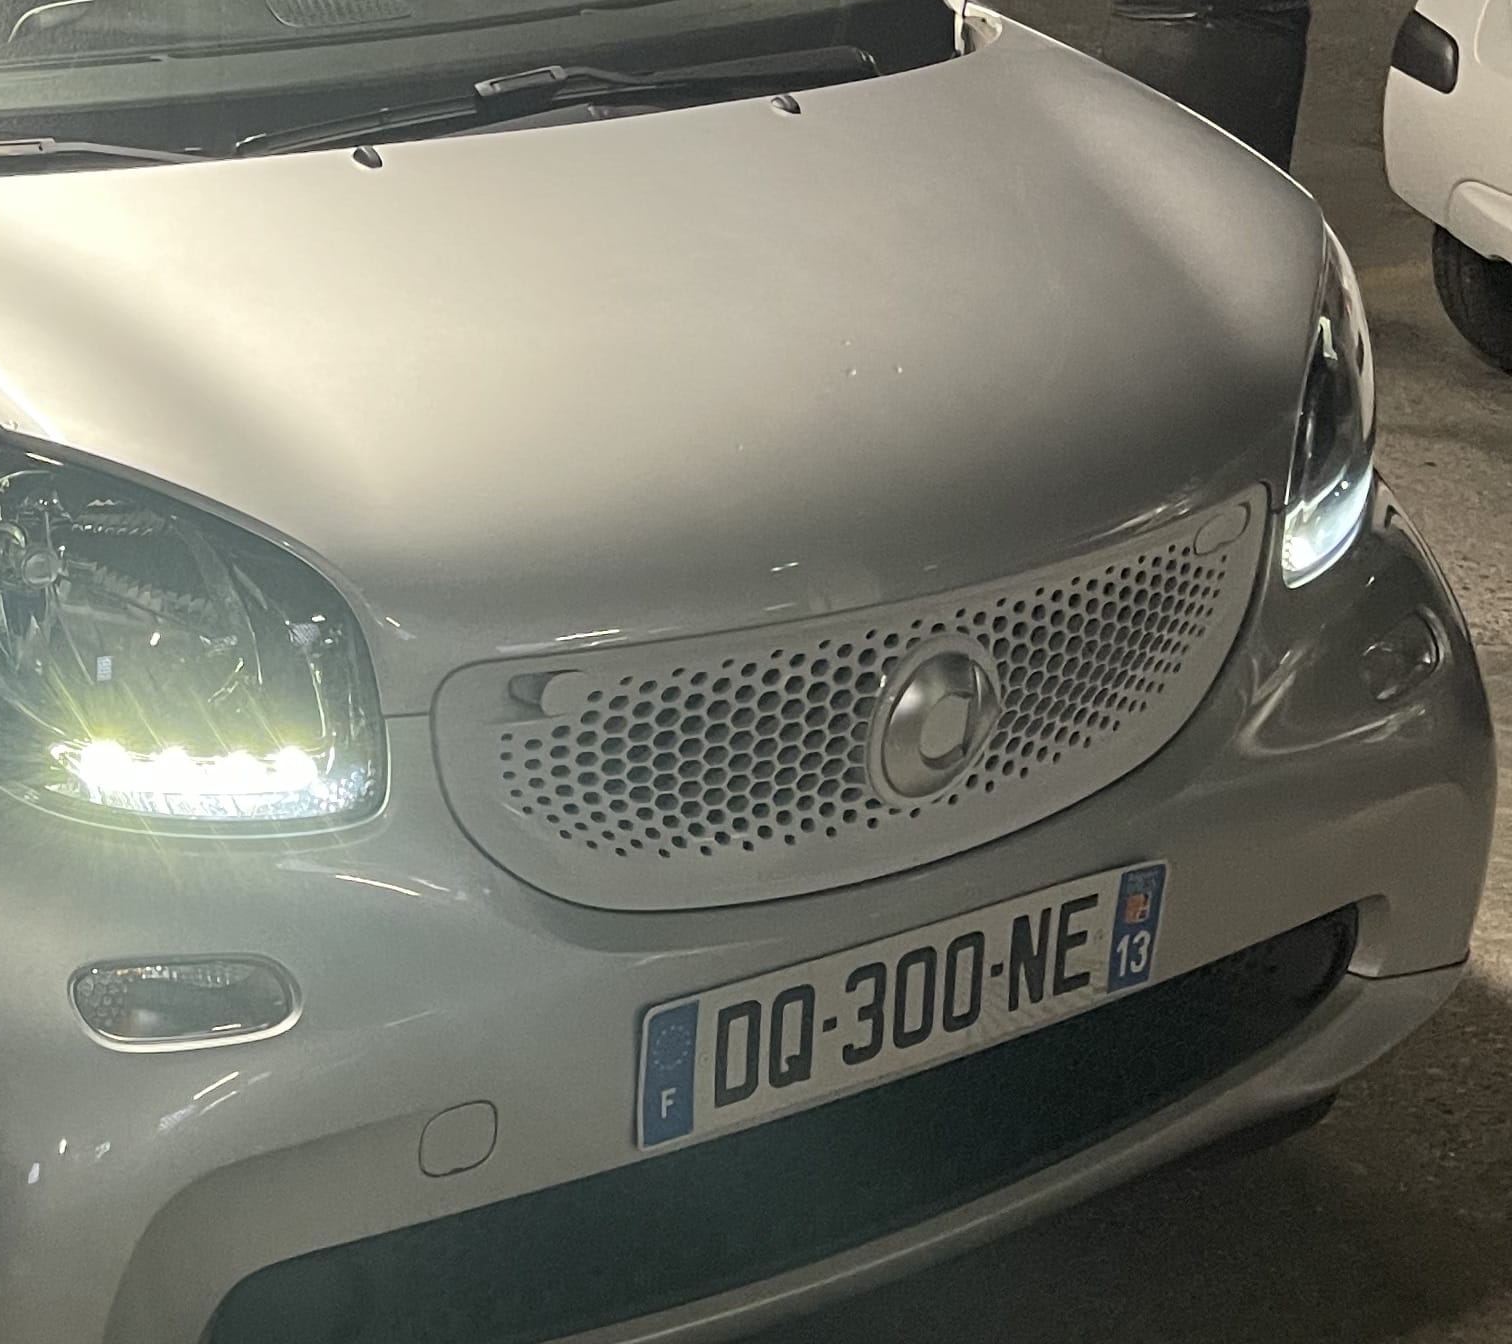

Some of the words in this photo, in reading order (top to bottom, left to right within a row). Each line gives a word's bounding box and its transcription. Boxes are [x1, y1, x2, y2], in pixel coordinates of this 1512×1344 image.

[661, 1087, 676, 1119] F
[714, 893, 1098, 1108] DQ-300-NE
[1116, 930, 1151, 976] 13
